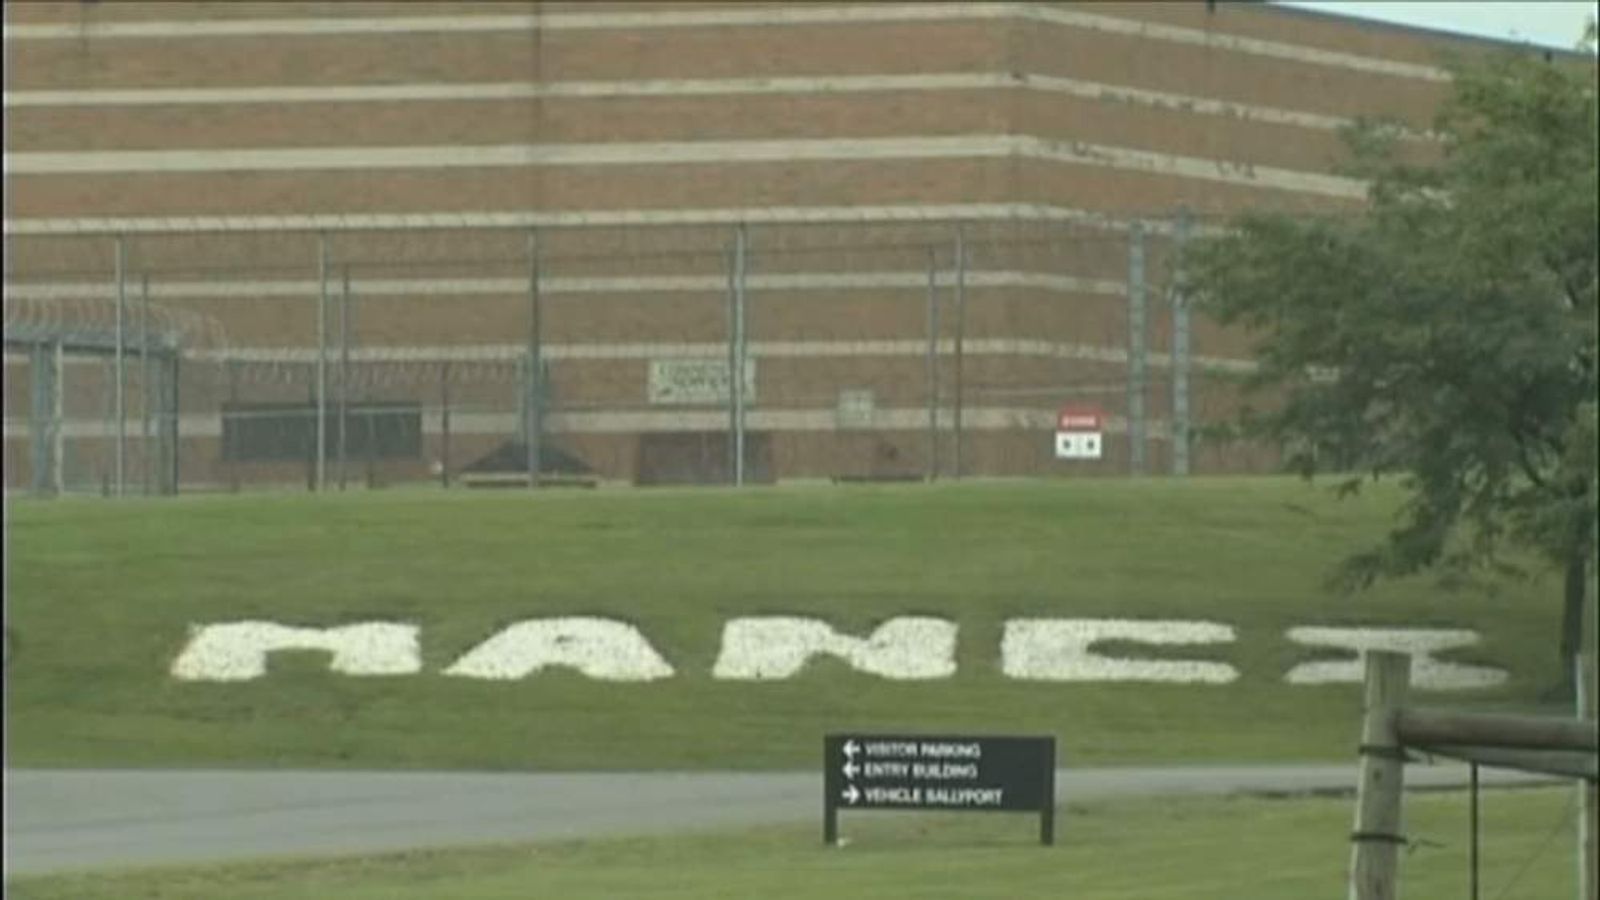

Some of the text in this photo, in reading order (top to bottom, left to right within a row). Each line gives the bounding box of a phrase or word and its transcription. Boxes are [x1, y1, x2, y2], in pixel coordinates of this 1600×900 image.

[864, 742, 981, 758] VISITOR PARKING
[864, 763, 978, 778] ENTRY BUILDING
[864, 788, 921, 802] VEHICLE
